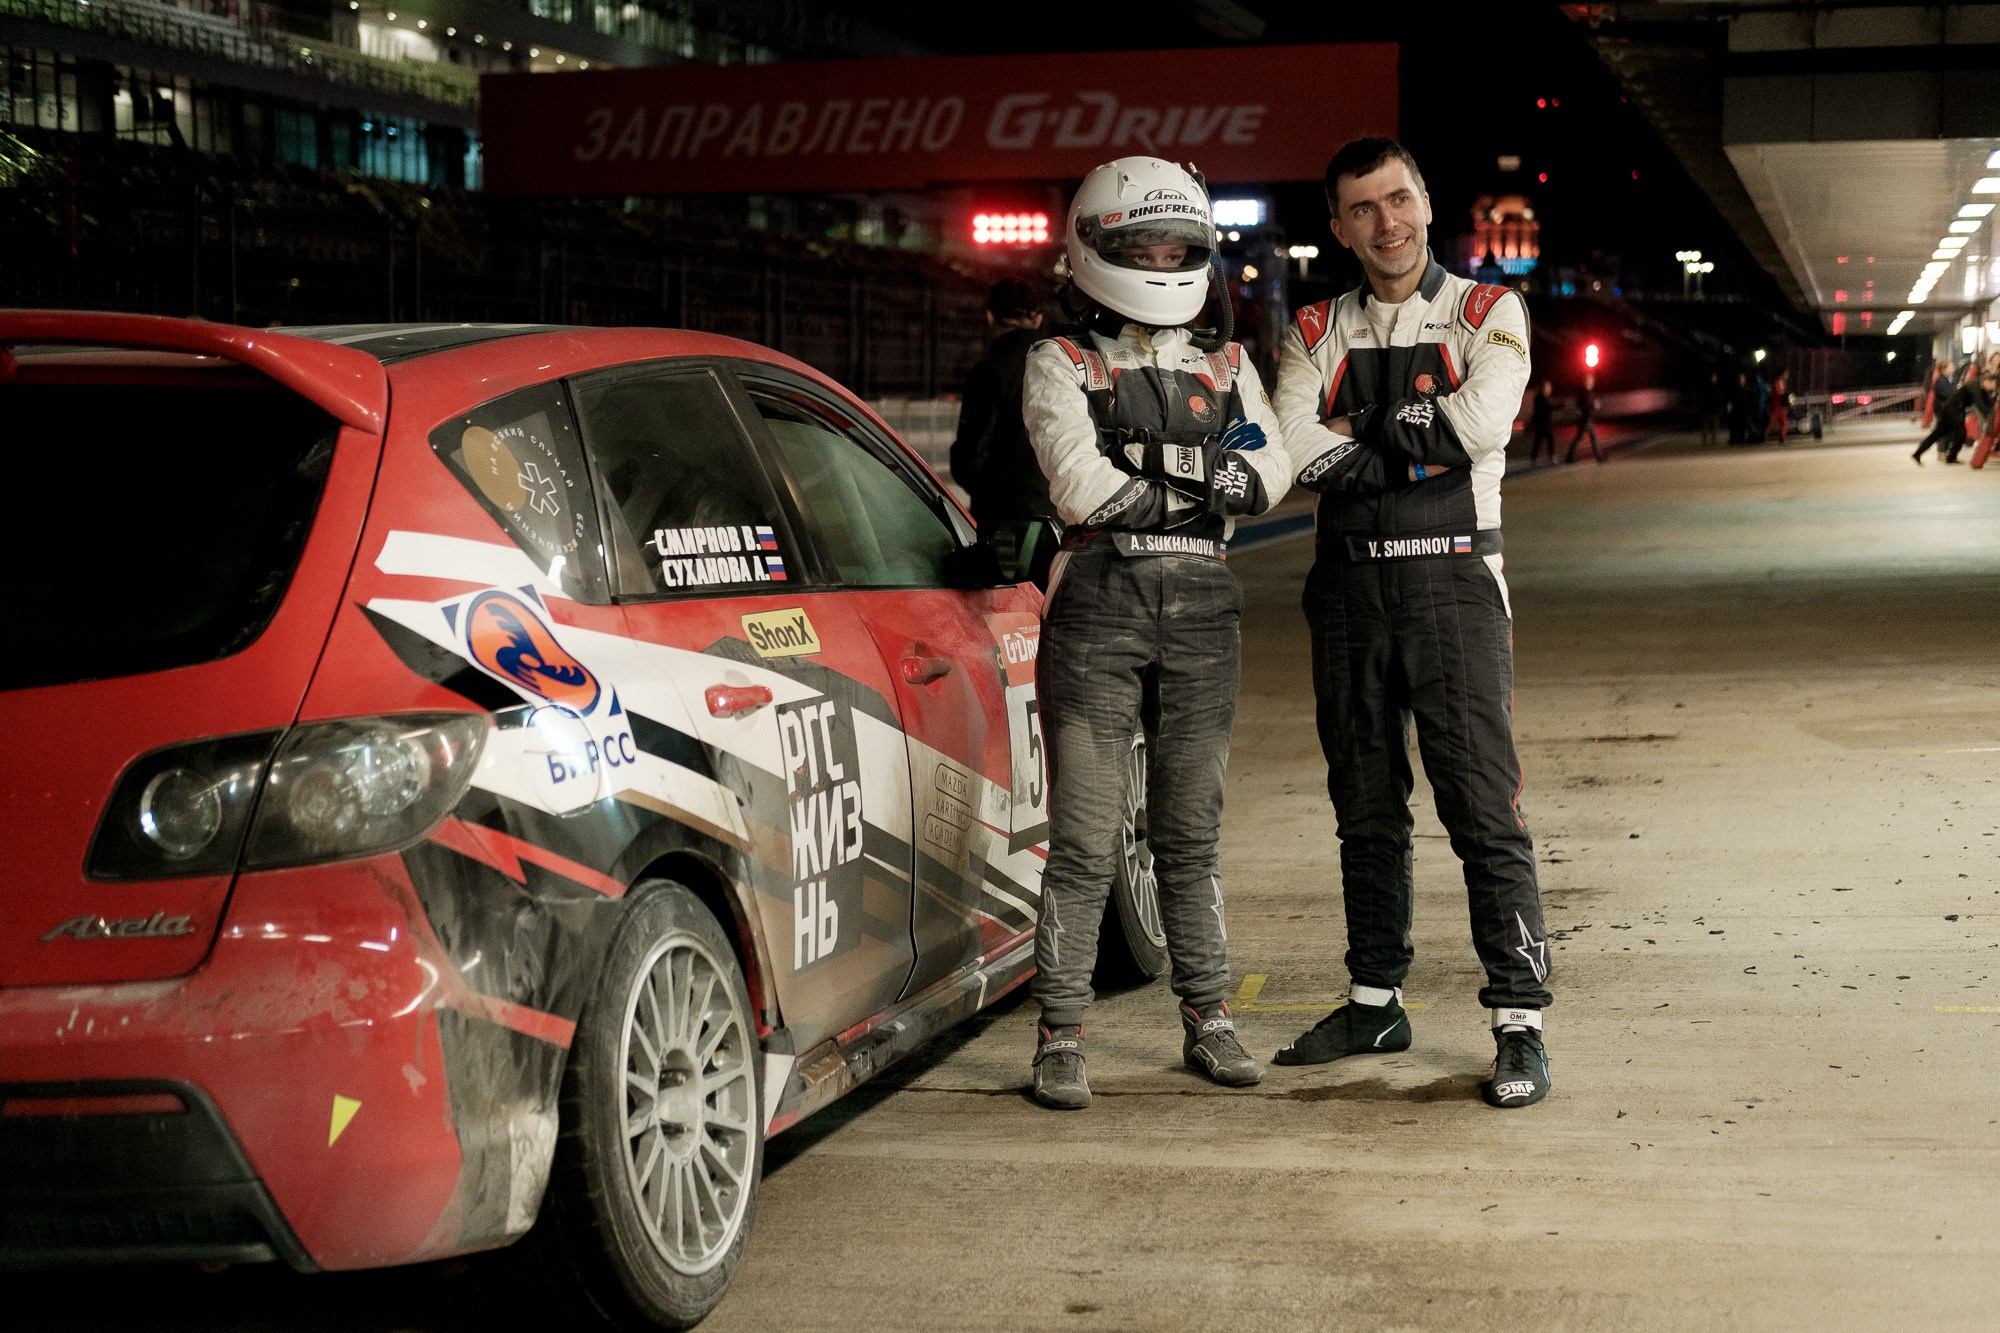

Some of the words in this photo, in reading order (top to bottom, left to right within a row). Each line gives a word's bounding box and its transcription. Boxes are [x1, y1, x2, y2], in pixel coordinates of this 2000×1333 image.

[574, 95, 965, 161] ЗАПРАВЛЕНО
[1128, 203, 1208, 220] RINGFREAKS
[1493, 332, 1527, 356] Shon
[654, 526, 741, 556] СМИРНОВ
[741, 525, 761, 551] В.
[1131, 535, 1144, 550] A.
[1146, 535, 1214, 556] SUKHANOVA
[1368, 541, 1381, 557] V.
[1384, 537, 1450, 557] SMIRNOV
[662, 556, 752, 587] СУХАНОВА
[753, 556, 771, 581] А.
[748, 616, 814, 650] ShonX
[777, 700, 844, 795] РГС
[941, 771, 967, 798] MAZDA
[789, 780, 864, 882] ЖИЗ
[38, 911, 195, 943] Axela
[793, 881, 839, 971] НЬ
[1496, 1083, 1535, 1097] OMP
